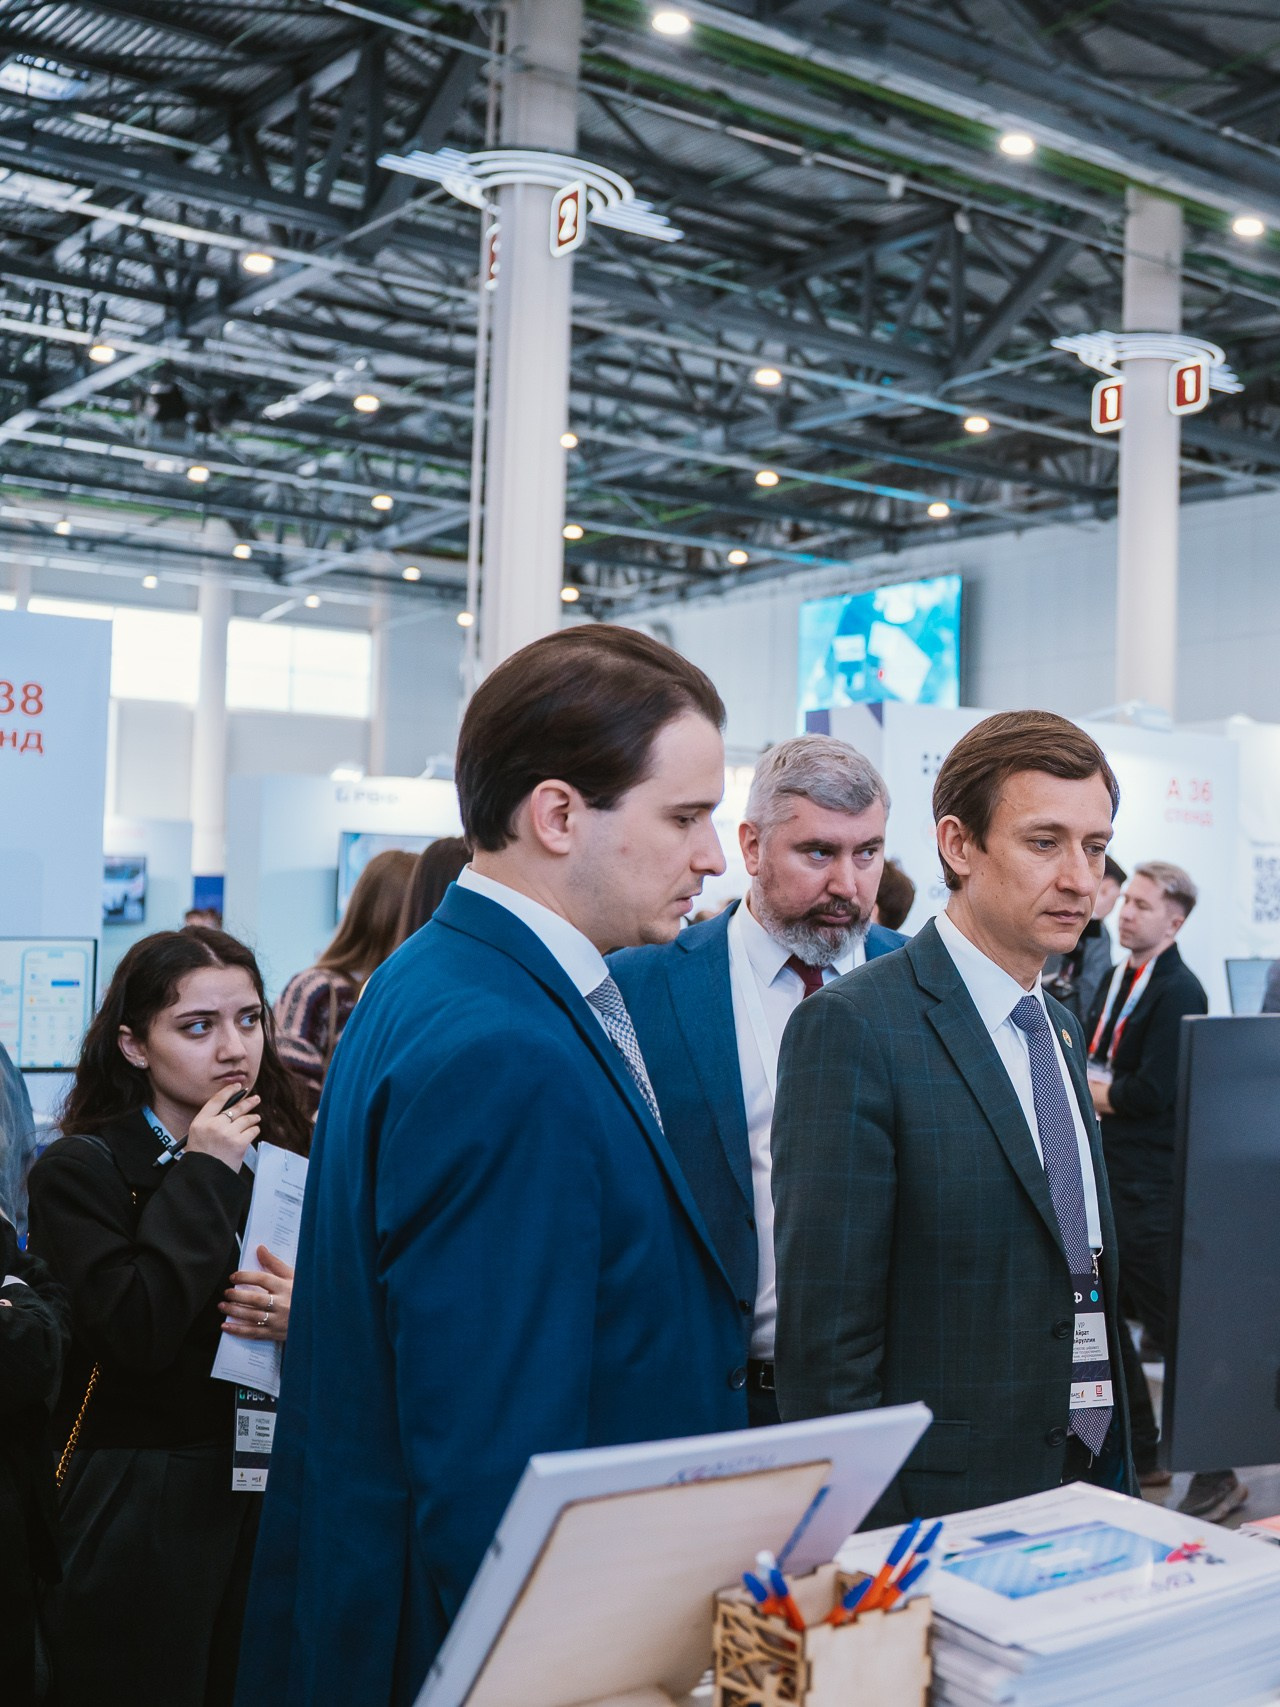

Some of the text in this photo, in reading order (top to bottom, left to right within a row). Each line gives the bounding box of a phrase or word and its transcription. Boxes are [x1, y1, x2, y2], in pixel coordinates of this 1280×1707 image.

[558, 198, 577, 241] 2
[1182, 369, 1197, 402] 1
[1104, 387, 1119, 421] 1
